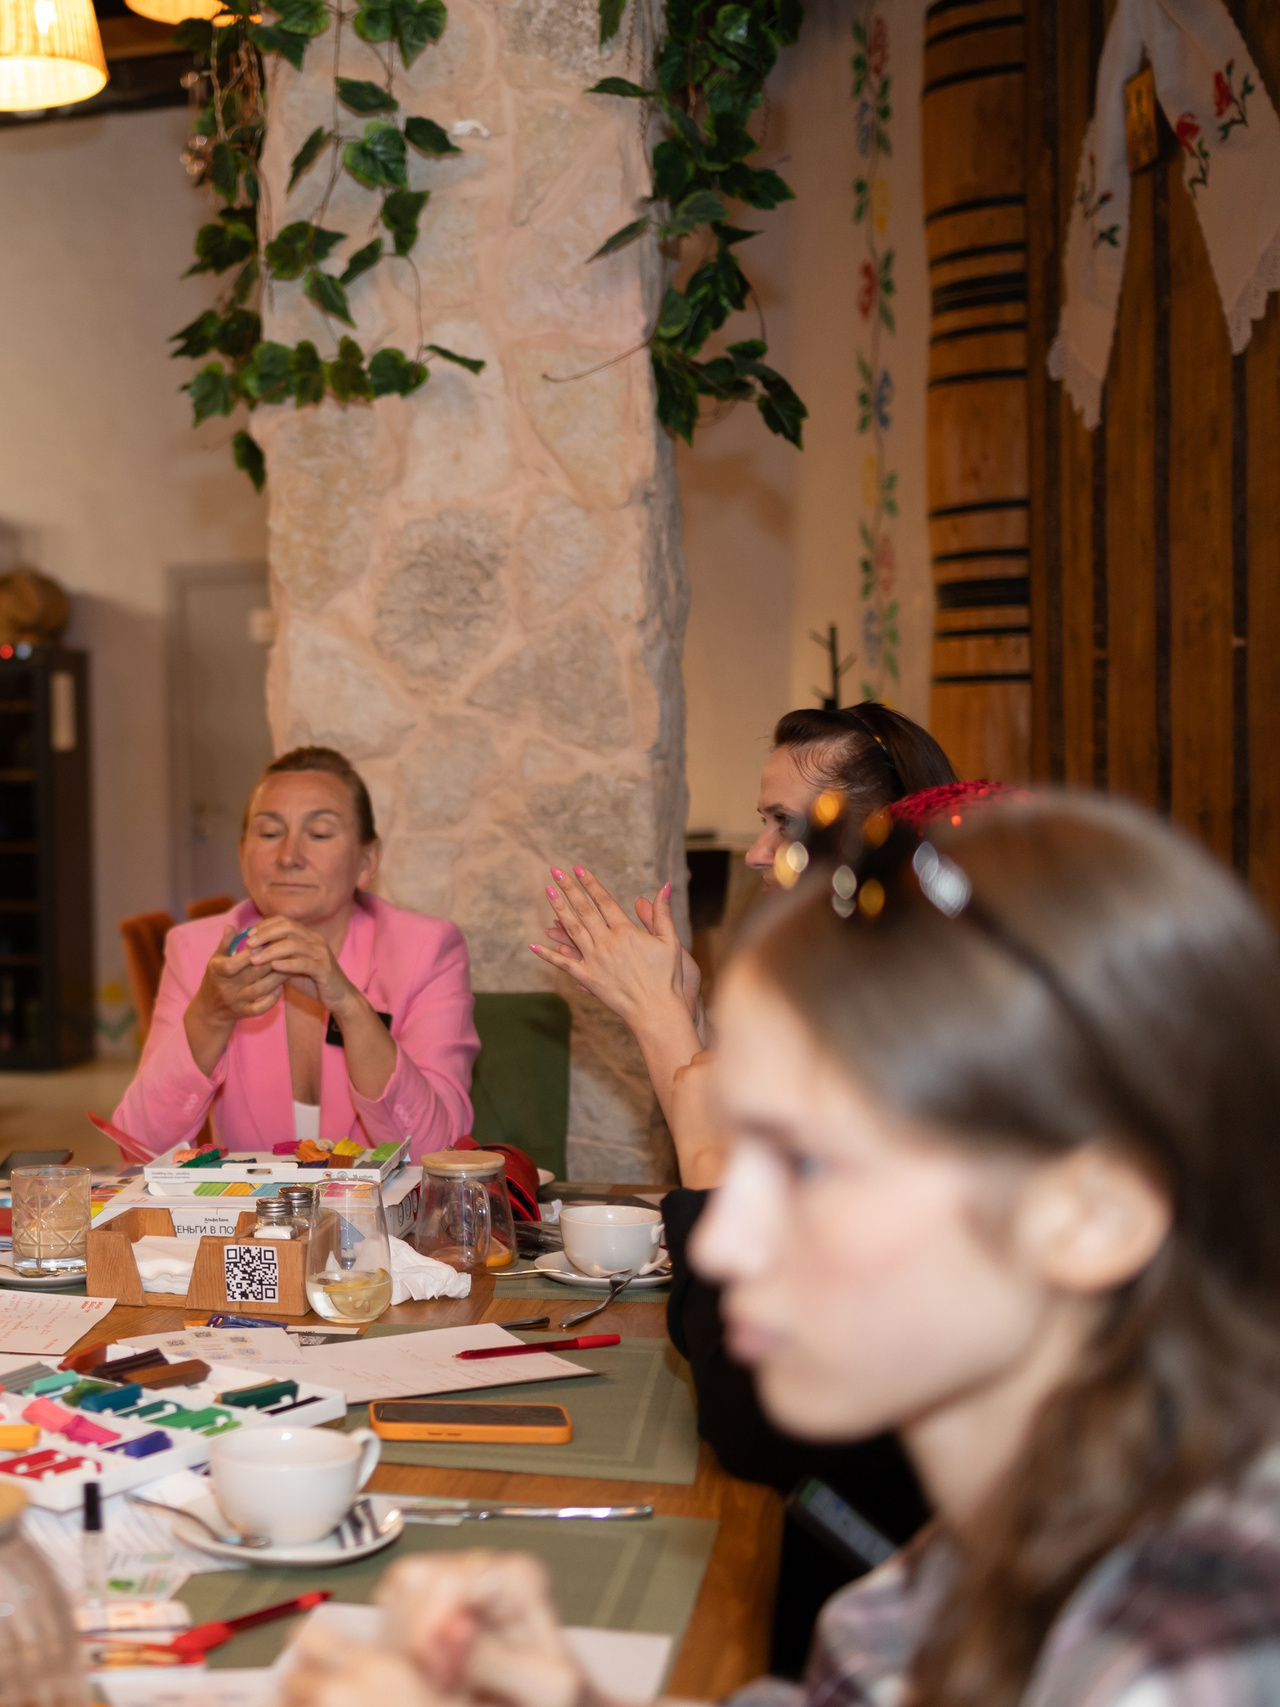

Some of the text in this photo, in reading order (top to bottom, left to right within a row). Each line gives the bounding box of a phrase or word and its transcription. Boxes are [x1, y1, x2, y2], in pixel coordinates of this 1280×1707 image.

[174, 1225, 237, 1235] ЕНЬГИ В ПО
